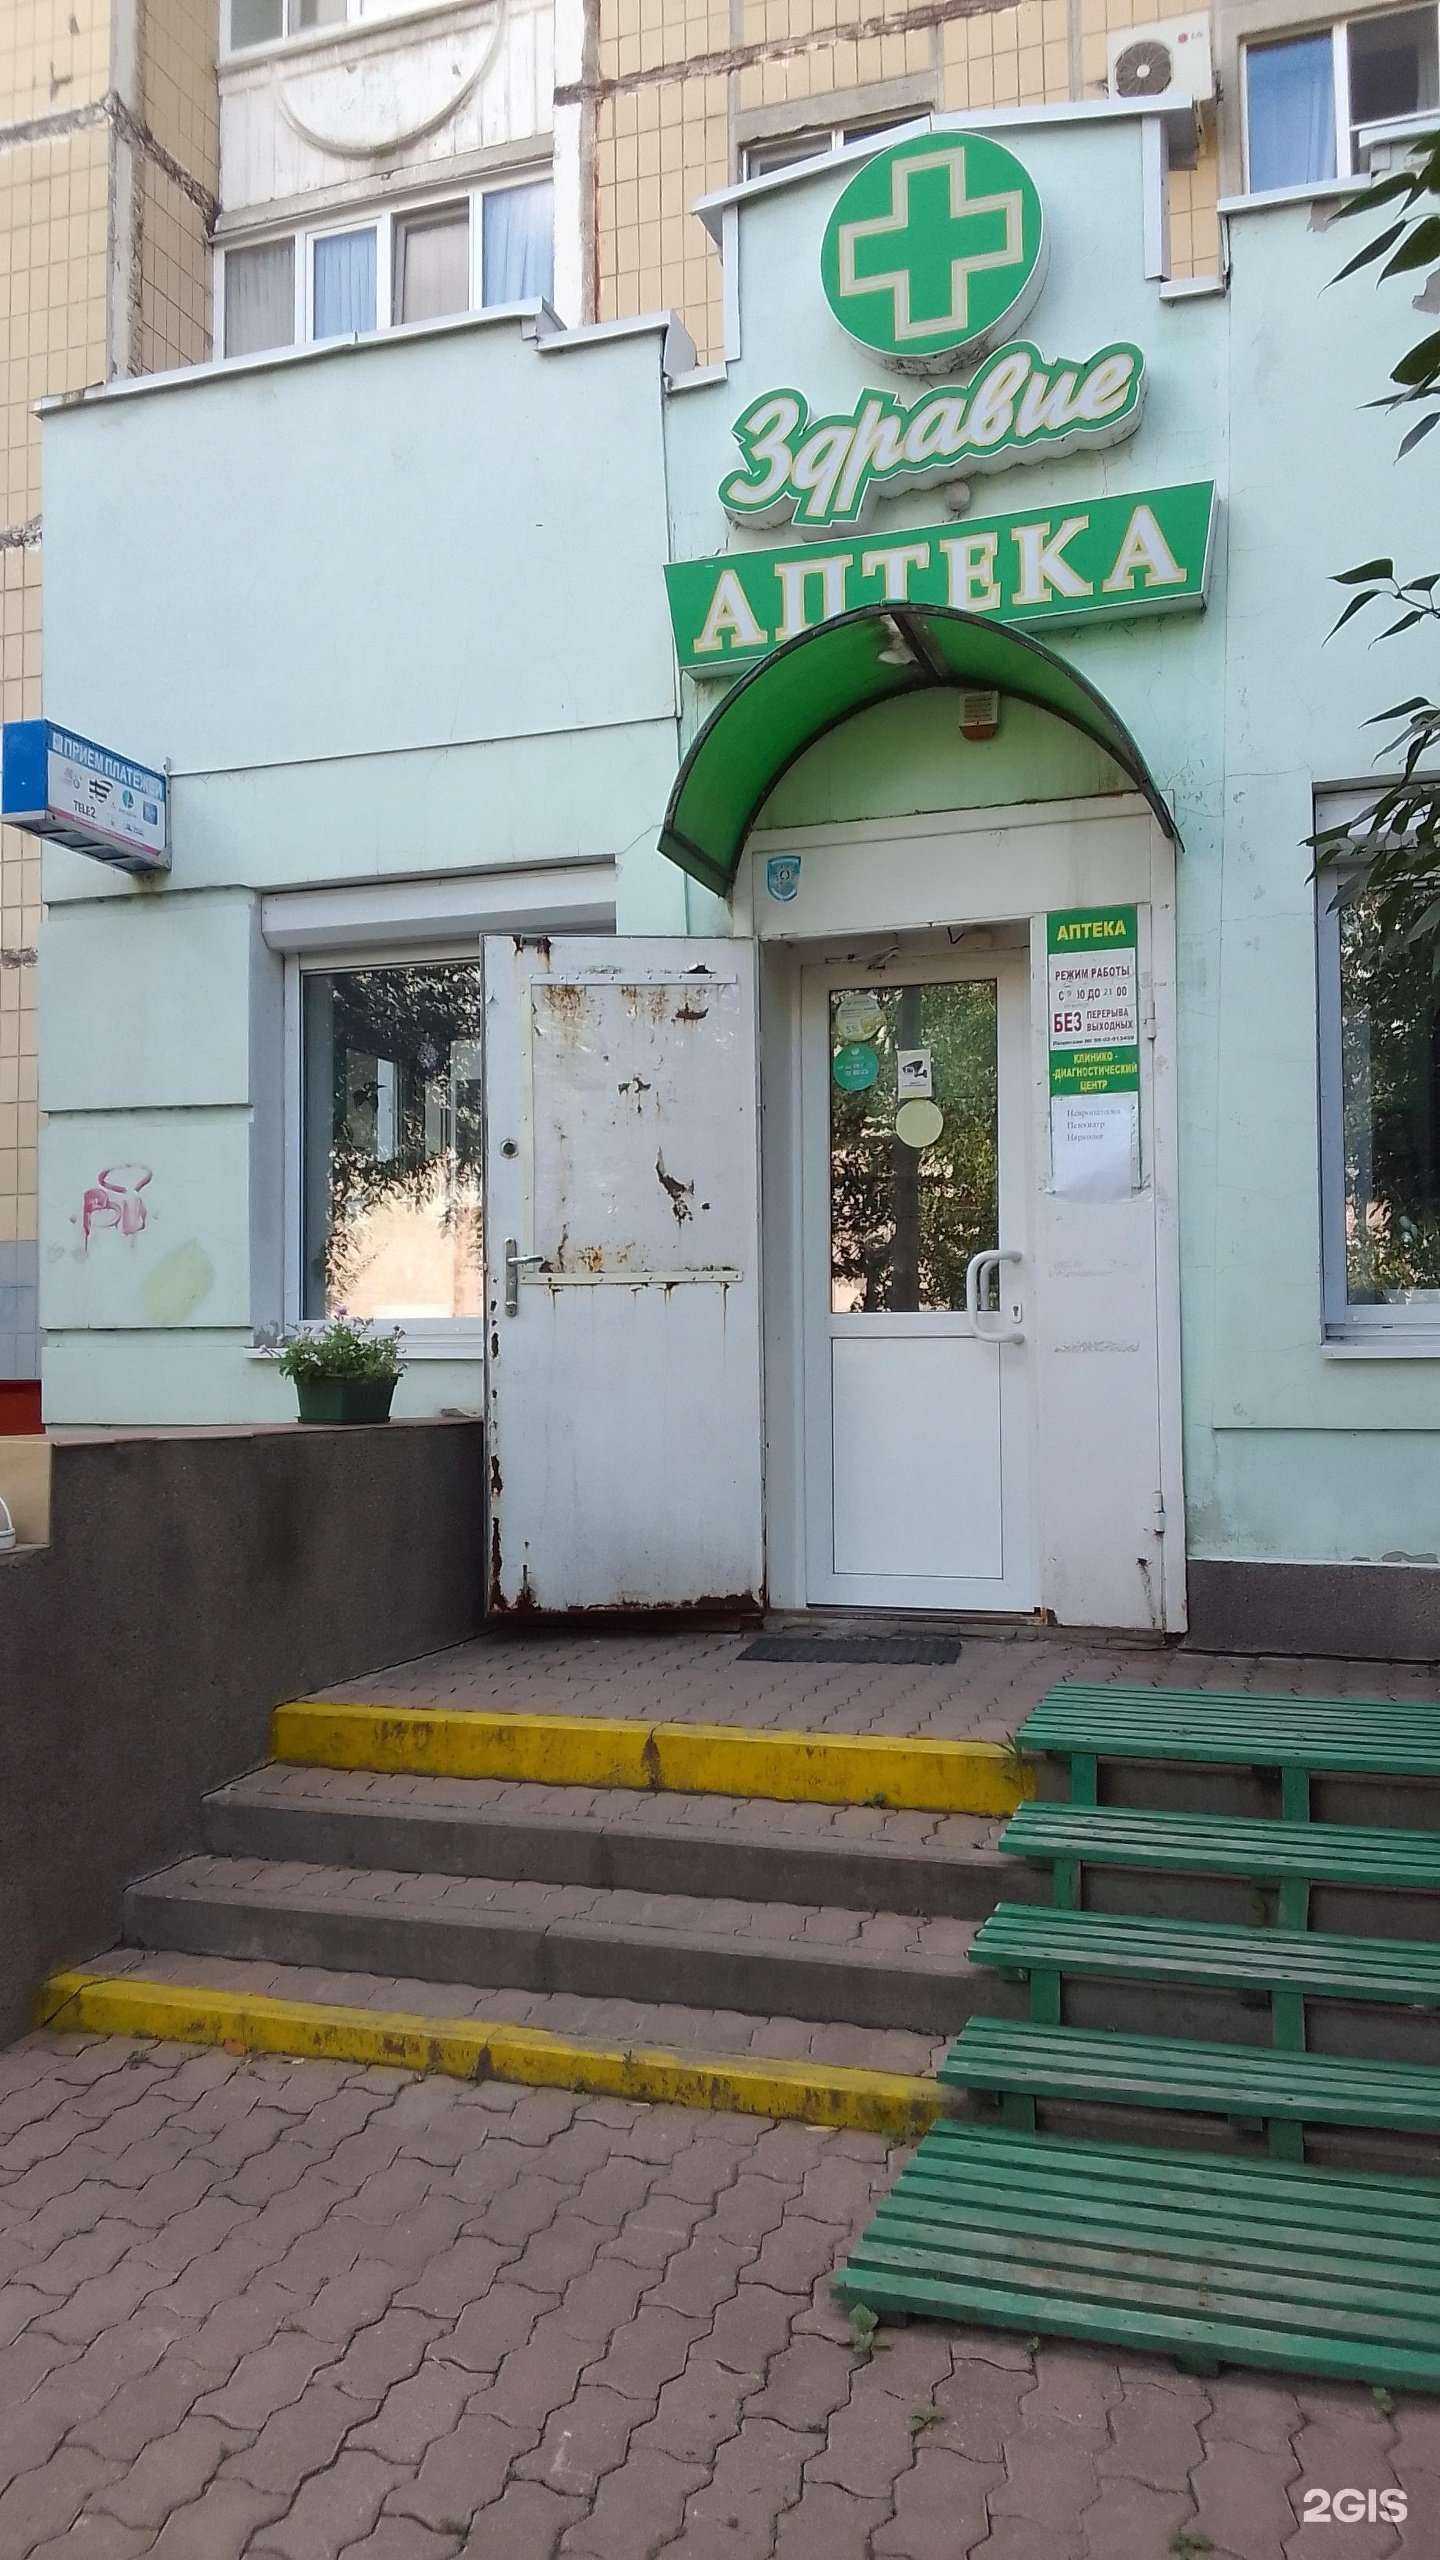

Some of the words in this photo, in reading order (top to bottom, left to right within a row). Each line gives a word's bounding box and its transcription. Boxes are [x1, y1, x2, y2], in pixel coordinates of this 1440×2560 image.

[723, 347, 1139, 520] Здравие
[692, 504, 1188, 653] АПТЕКА
[63, 737, 104, 771] ПРИЕМ
[73, 800, 97, 819] TELE2
[1056, 920, 1127, 941] АПТЕКА
[1055, 968, 1089, 981] РЕЖИМ
[1091, 965, 1130, 978] РАБОТЫ
[1058, 990, 1065, 1001] С
[1087, 988, 1101, 1001] ДО
[1116, 985, 1128, 997] 00
[1053, 1011, 1083, 1033] БЕЗ
[1086, 1007, 1129, 1019] ПЕРЕРЫВА
[1086, 1020, 1134, 1032] ВЫХОДНЫХ
[1080, 1079, 1108, 1092] ЦЕНТР
